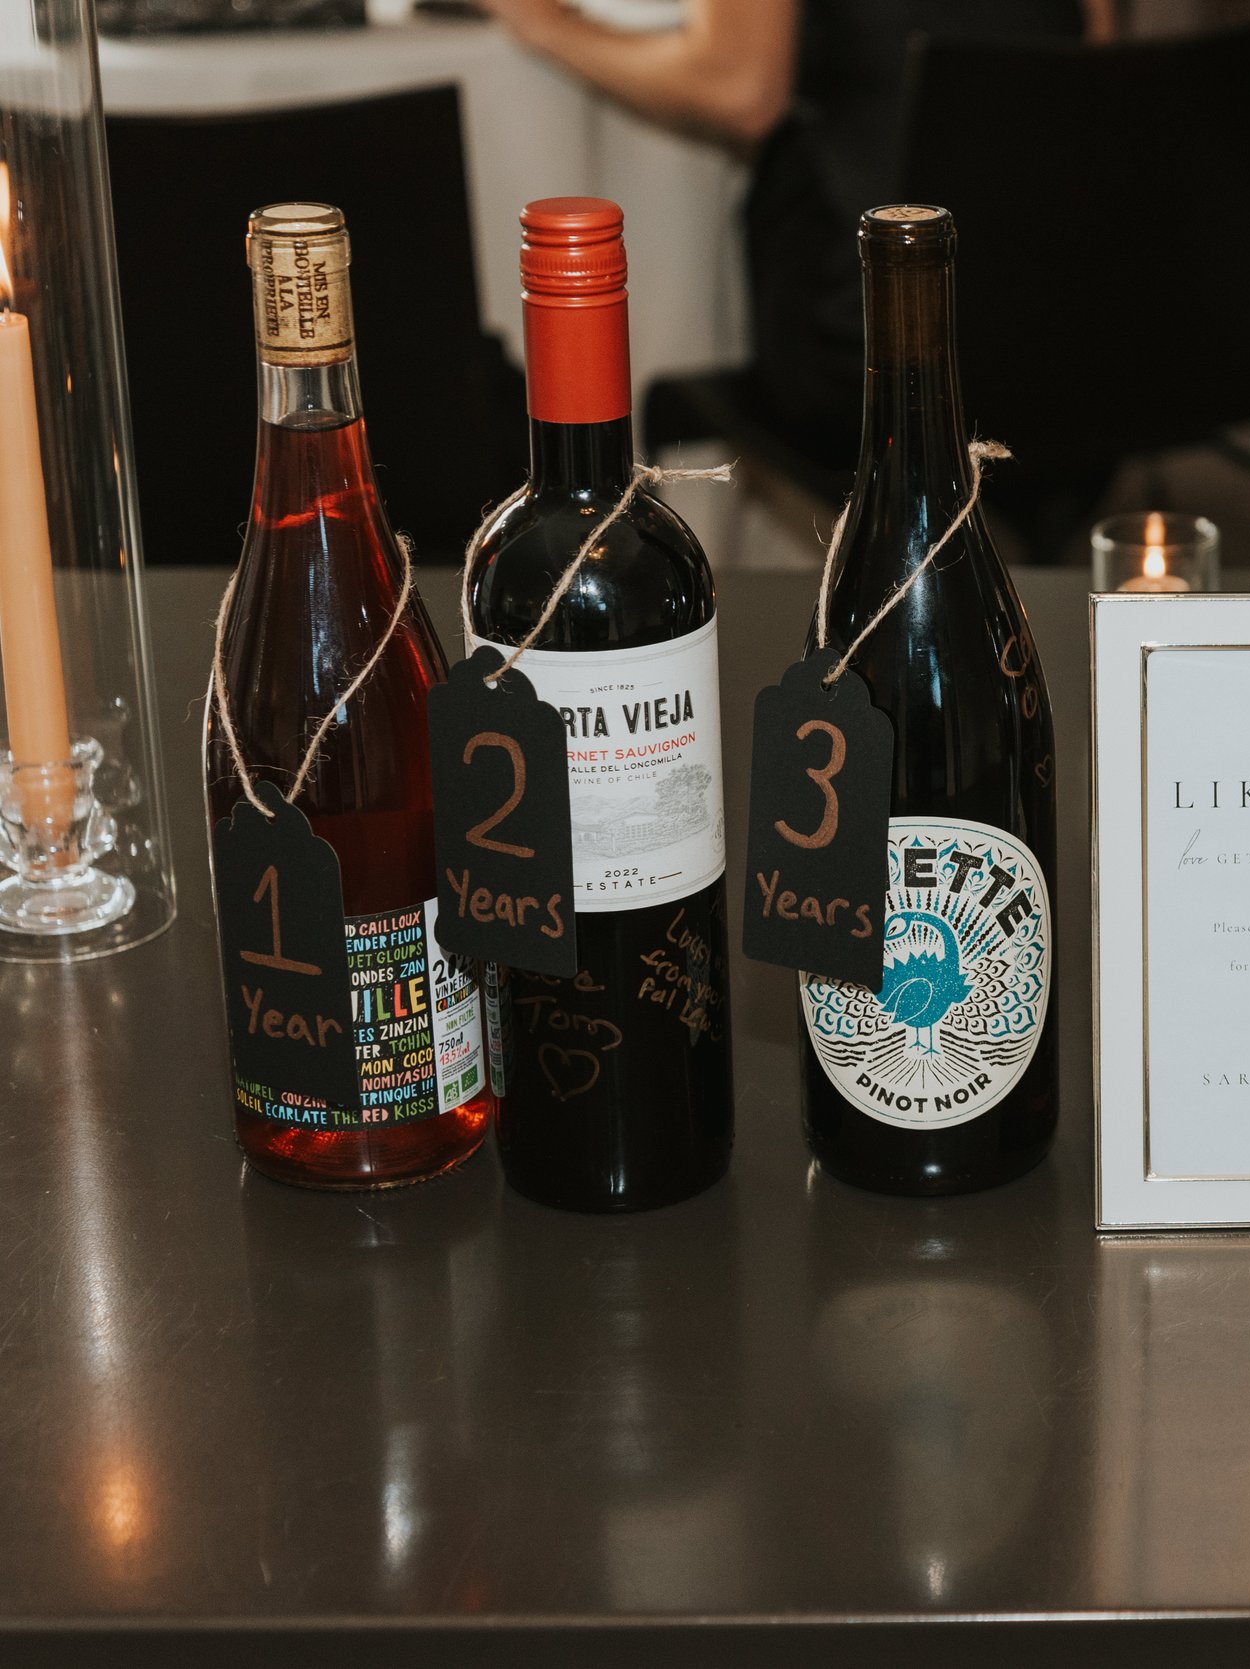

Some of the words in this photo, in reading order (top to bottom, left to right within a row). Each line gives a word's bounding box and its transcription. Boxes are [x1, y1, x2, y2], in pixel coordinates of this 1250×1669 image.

[313, 261, 328, 291] MIS
[316, 295, 330, 319] EN
[589, 684, 614, 694] SINCE
[559, 705, 611, 739] RTA
[622, 689, 695, 735] VIEJA
[566, 750, 608, 762] RNET
[615, 731, 697, 761] SAUVIGNON
[568, 765, 597, 774] ALLE
[601, 764, 620, 773] DEL
[624, 752, 683, 771] LONCOMILLA
[573, 776, 602, 785] WINE
[608, 776, 622, 784] OF
[628, 770, 658, 782] CHILE
[773, 719, 847, 850] 3
[462, 731, 536, 859] 2
[1178, 828, 1209, 870] love
[586, 875, 657, 892] ESTATE
[604, 867, 639, 878] 2022
[445, 867, 566, 940] Years
[756, 869, 874, 940] Years
[903, 846, 1035, 940] ETTE
[239, 865, 322, 976] 1
[359, 910, 421, 936] CAILLOUX
[346, 935, 387, 953] ENDER
[390, 926, 423, 946] FLUID
[348, 953, 372, 968] UET
[376, 942, 423, 964] GLOUPS
[400, 958, 425, 978] ZAN
[1230, 960, 1249, 972] for
[435, 983, 449, 999] VIN
[241, 984, 344, 1048] Year
[380, 1013, 429, 1041] ZINZIN
[389, 1030, 431, 1055] TCHIN
[361, 1058, 393, 1076] MON
[403, 1047, 433, 1068] COCO
[236, 1088, 262, 1113] SOLEIL
[265, 1102, 328, 1125] ECARLATE
[331, 1110, 359, 1126] THE
[362, 1108, 389, 1123] RED
[394, 1097, 434, 1121] KISSS
[360, 1083, 418, 1106] TRINQUE
[855, 1071, 929, 1115] PINOT
[934, 1071, 994, 1114] NOIR
